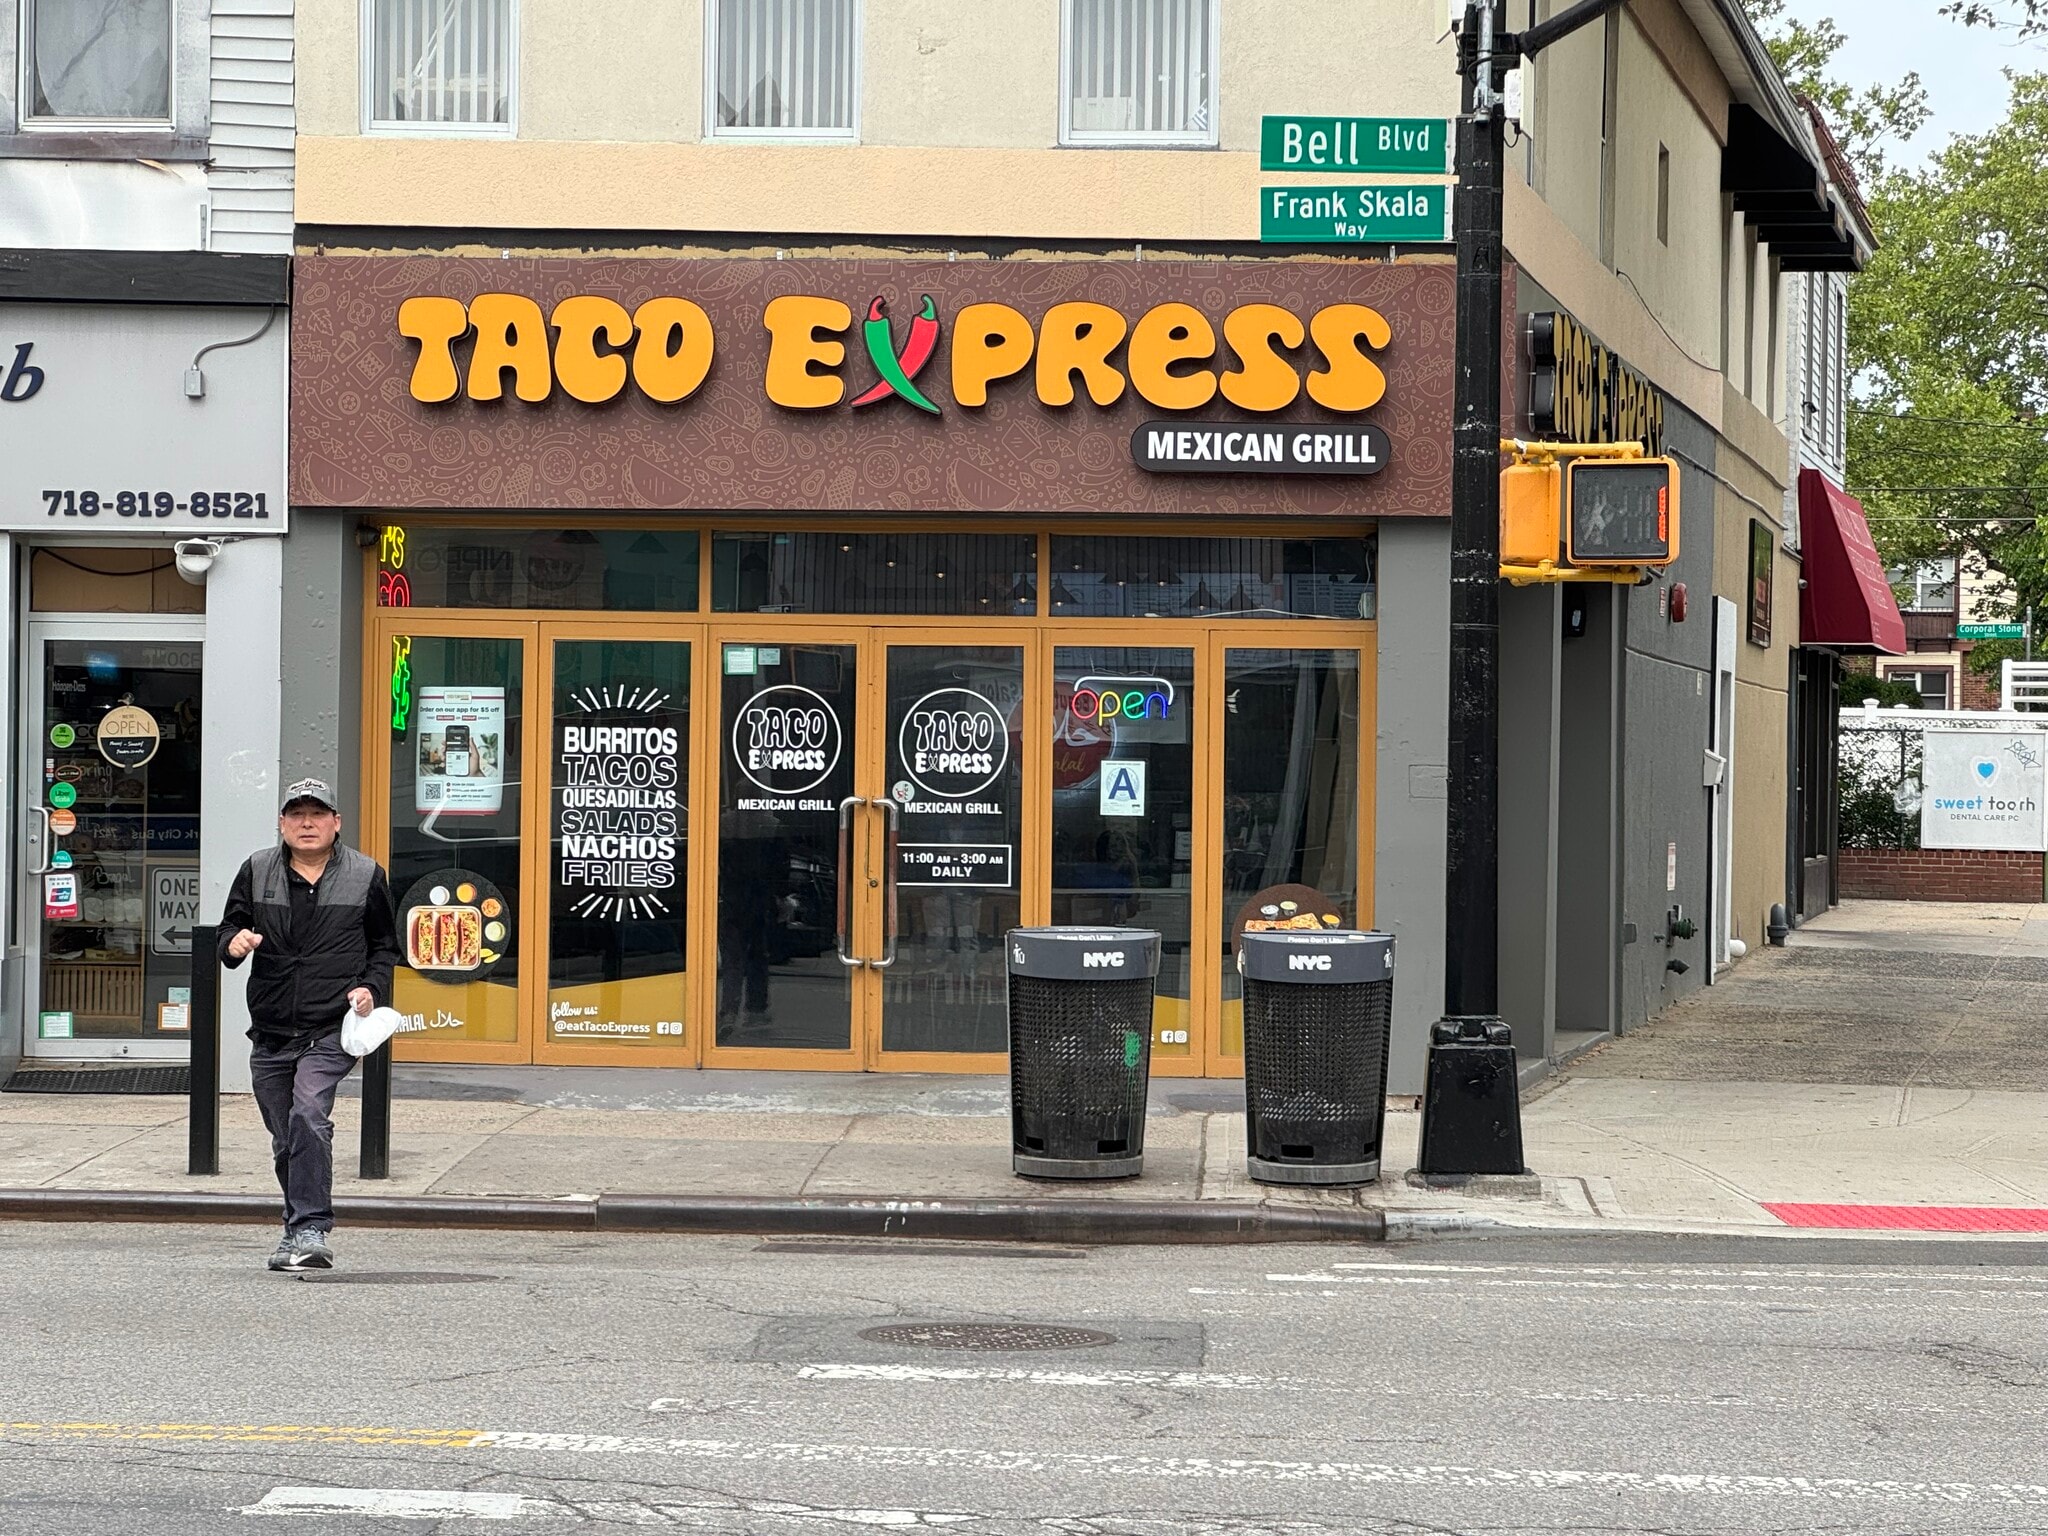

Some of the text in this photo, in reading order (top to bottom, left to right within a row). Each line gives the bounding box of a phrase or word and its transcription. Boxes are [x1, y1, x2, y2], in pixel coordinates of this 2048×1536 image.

[1283, 122, 1430, 165] Bell Blvd
[1273, 190, 1429, 219] Frank Skala
[1334, 222, 1368, 239] Way
[397, 293, 717, 405] TACO
[1147, 430, 1377, 465] MEXICAN GRILL
[42, 490, 269, 518] 718-819-8521
[1959, 625, 2022, 635] Corporal Stone
[1071, 689, 1169, 727] open
[105, 720, 151, 736] OPEN
[747, 707, 827, 749] TACO
[913, 710, 995, 752] TACO
[564, 726, 678, 755] BURRITOS
[562, 754, 678, 788] TACOS
[1108, 768, 1138, 800] A
[562, 788, 676, 809] QUESADILLAS
[738, 798, 835, 811] MEXICAN GRILL
[904, 802, 1003, 815] MEXICAN GRILL
[1934, 795, 1983, 810] sweet
[561, 809, 677, 837] SALADS
[562, 835, 676, 860] NACHOS
[902, 852, 934, 864] 11:00
[936, 855, 951, 864] AM
[961, 853, 987, 865] 3:00
[989, 856, 1004, 864] AM
[562, 860, 676, 888] FRIES
[931, 866, 973, 877] DAILY
[160, 878, 199, 896] ONE
[160, 901, 200, 919] WAY
[1083, 952, 1125, 968] NYC
[1288, 954, 1332, 971] NYC
[429, 1009, 464, 1028] حلال
[551, 1001, 598, 1021] follow us:
[554, 1020, 651, 1035] @eatTacoExpress
